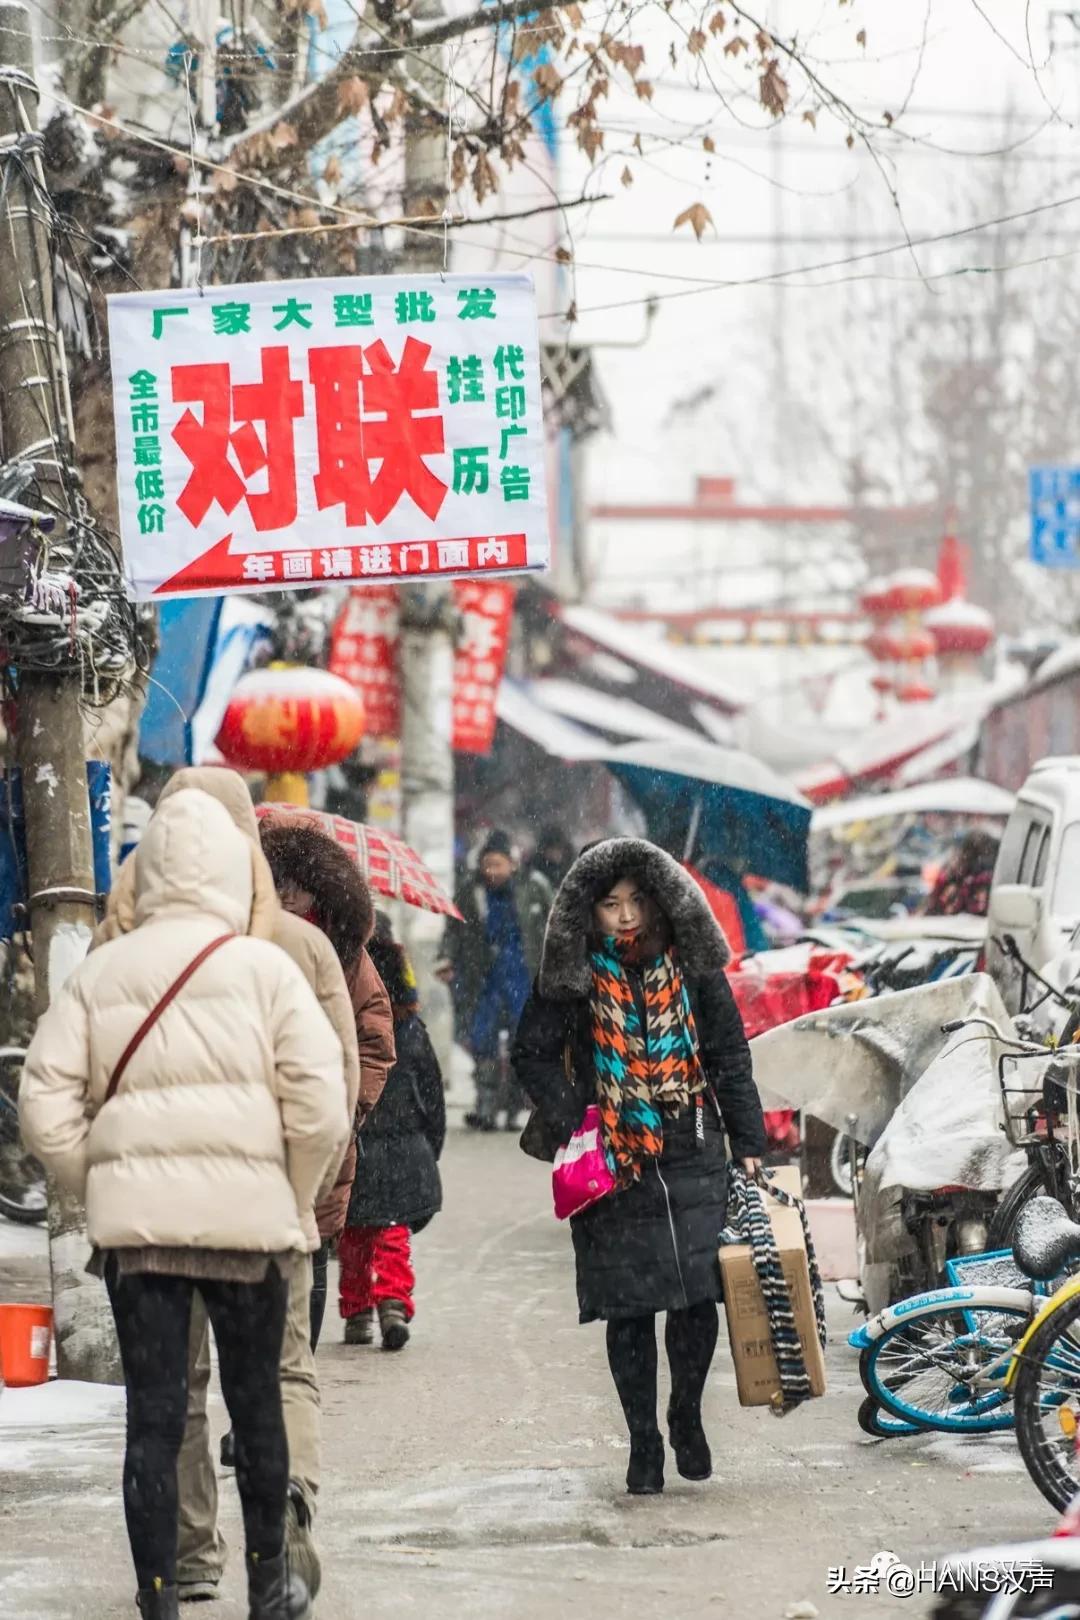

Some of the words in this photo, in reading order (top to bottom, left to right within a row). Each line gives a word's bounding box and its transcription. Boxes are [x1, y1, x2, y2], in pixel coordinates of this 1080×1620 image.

[152, 287, 497, 340] 厂家大型批发
[128, 369, 167, 535] 全市最低价
[170, 335, 448, 532] 对联
[446, 354, 489, 497] 挂历
[493, 344, 531, 503] 代印广告
[696, 1107, 704, 1140] SNOW
